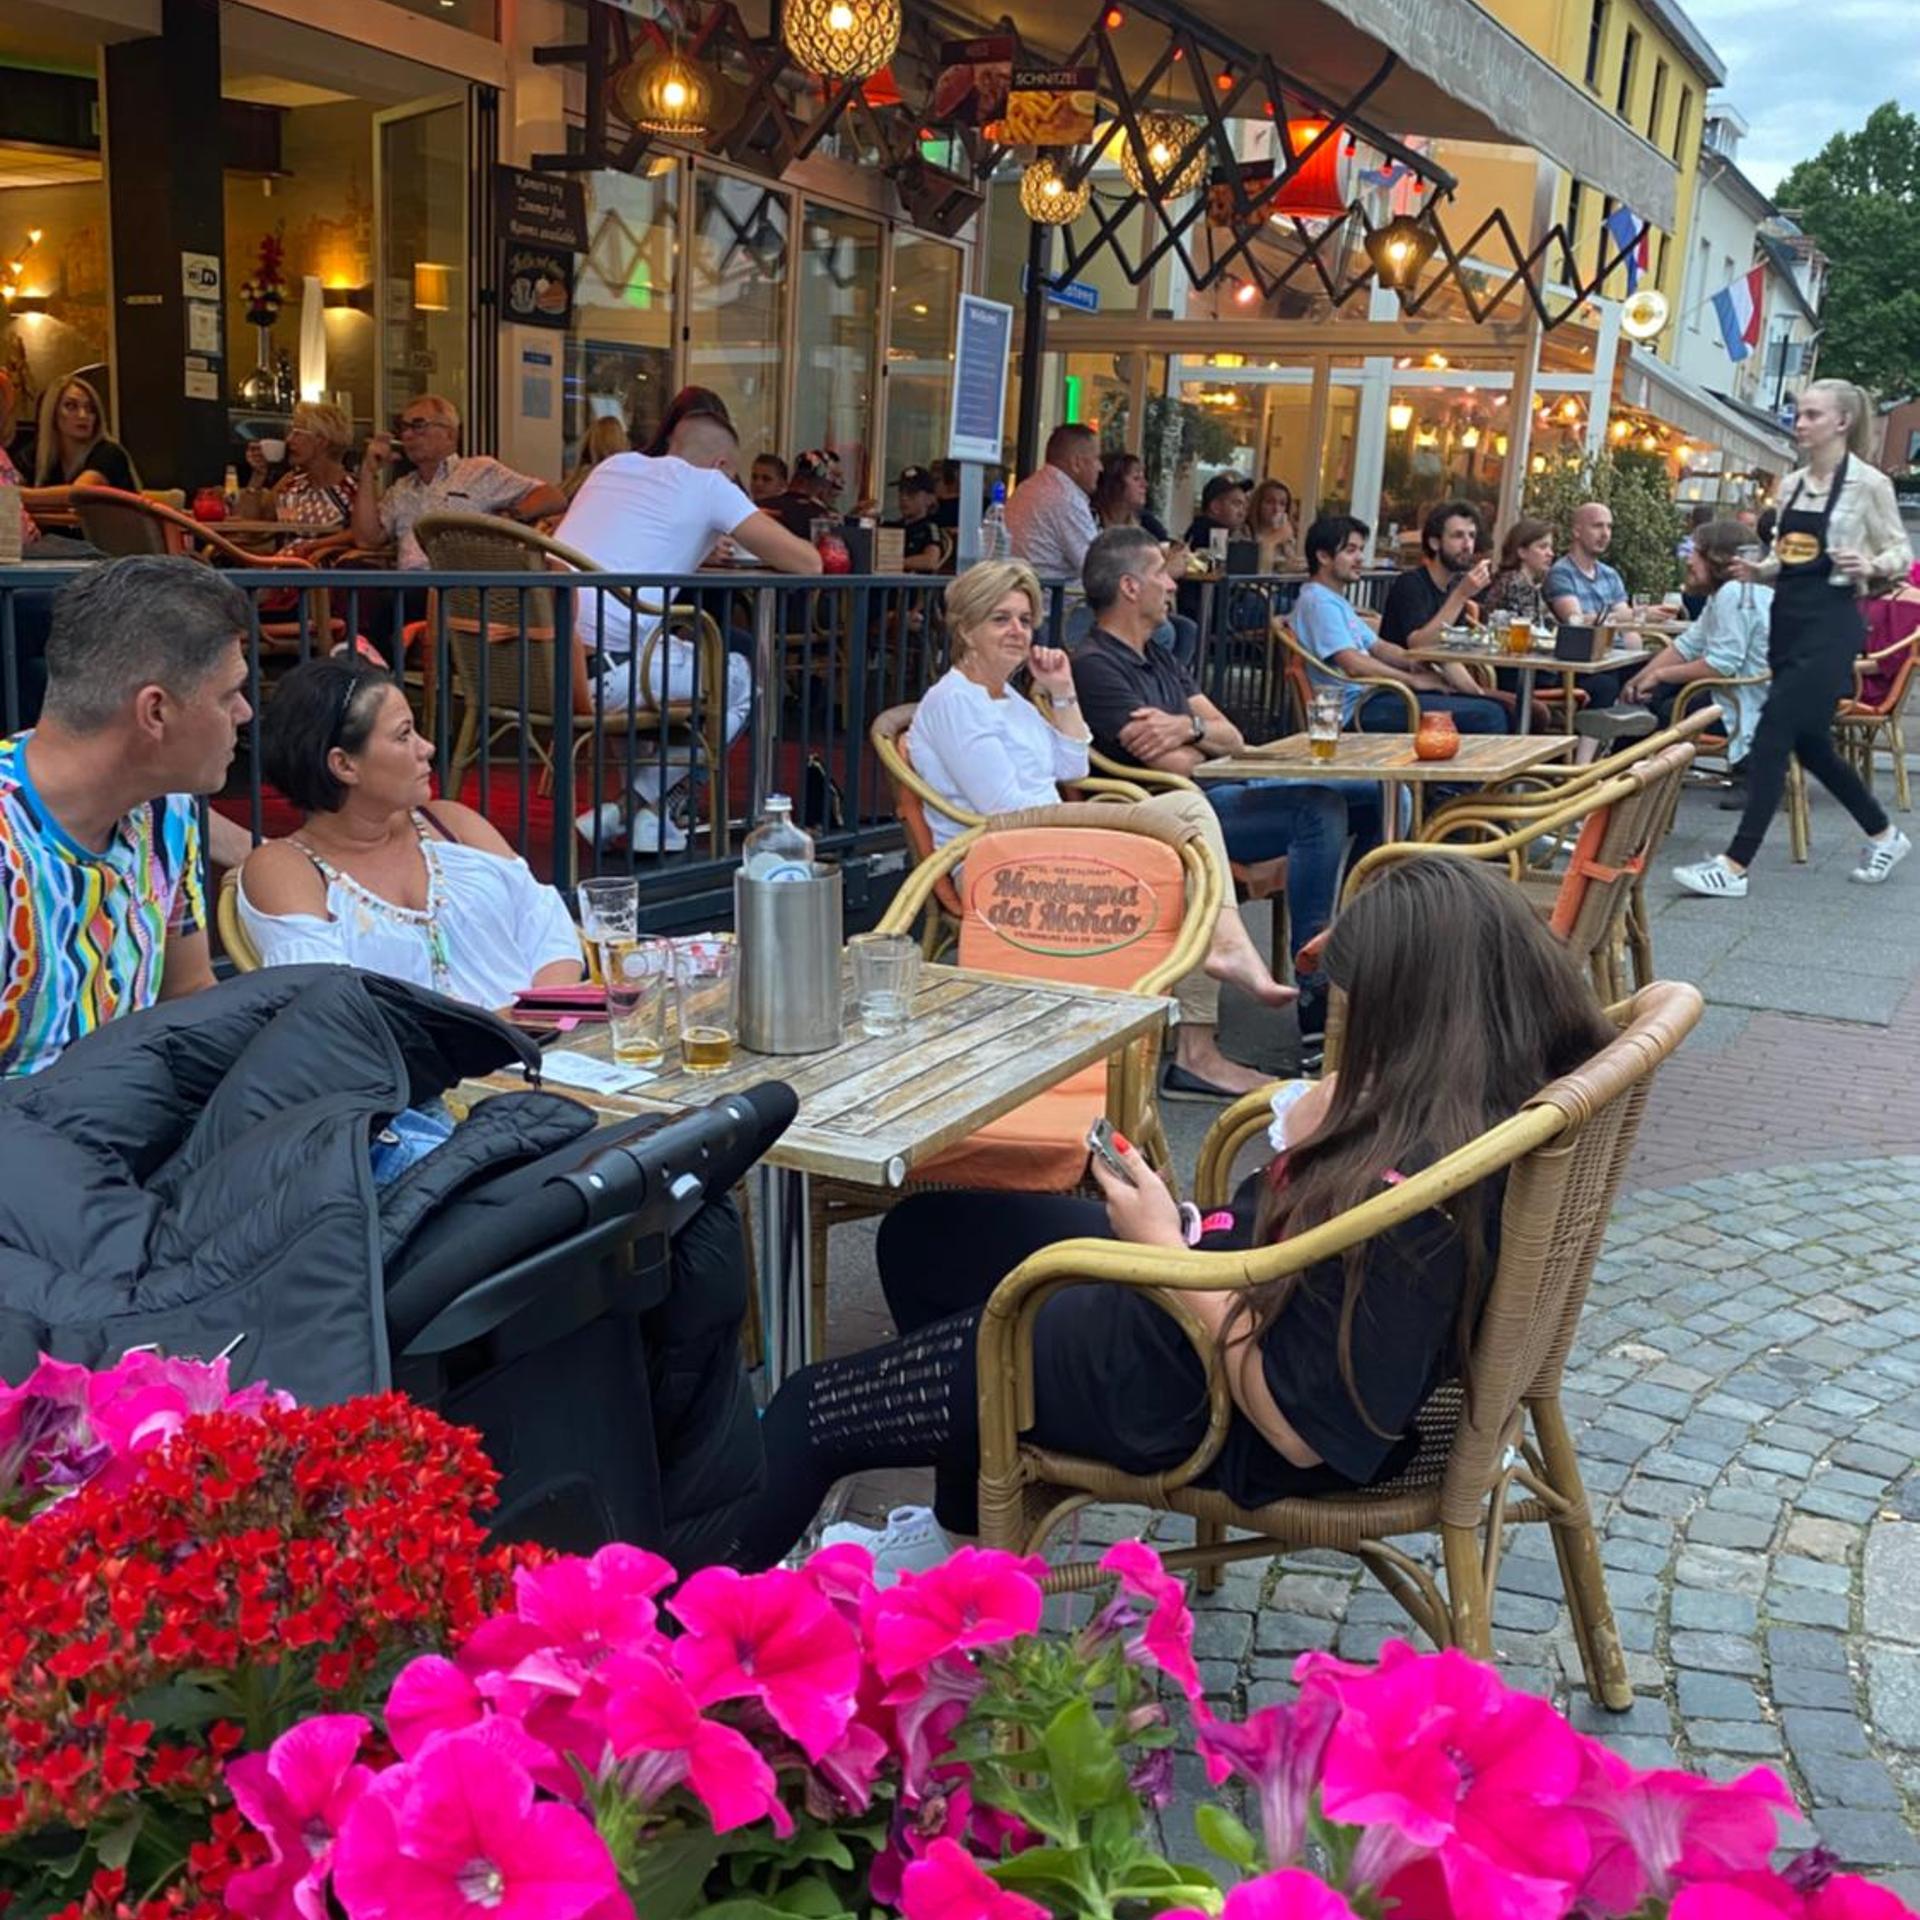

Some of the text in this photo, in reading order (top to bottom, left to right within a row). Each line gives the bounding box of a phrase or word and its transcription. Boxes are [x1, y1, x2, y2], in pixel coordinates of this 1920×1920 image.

[1015, 71, 1078, 87] SCHNITZEL
[992, 868, 1139, 908] Montagna
[988, 900, 1141, 935] del Mondo
